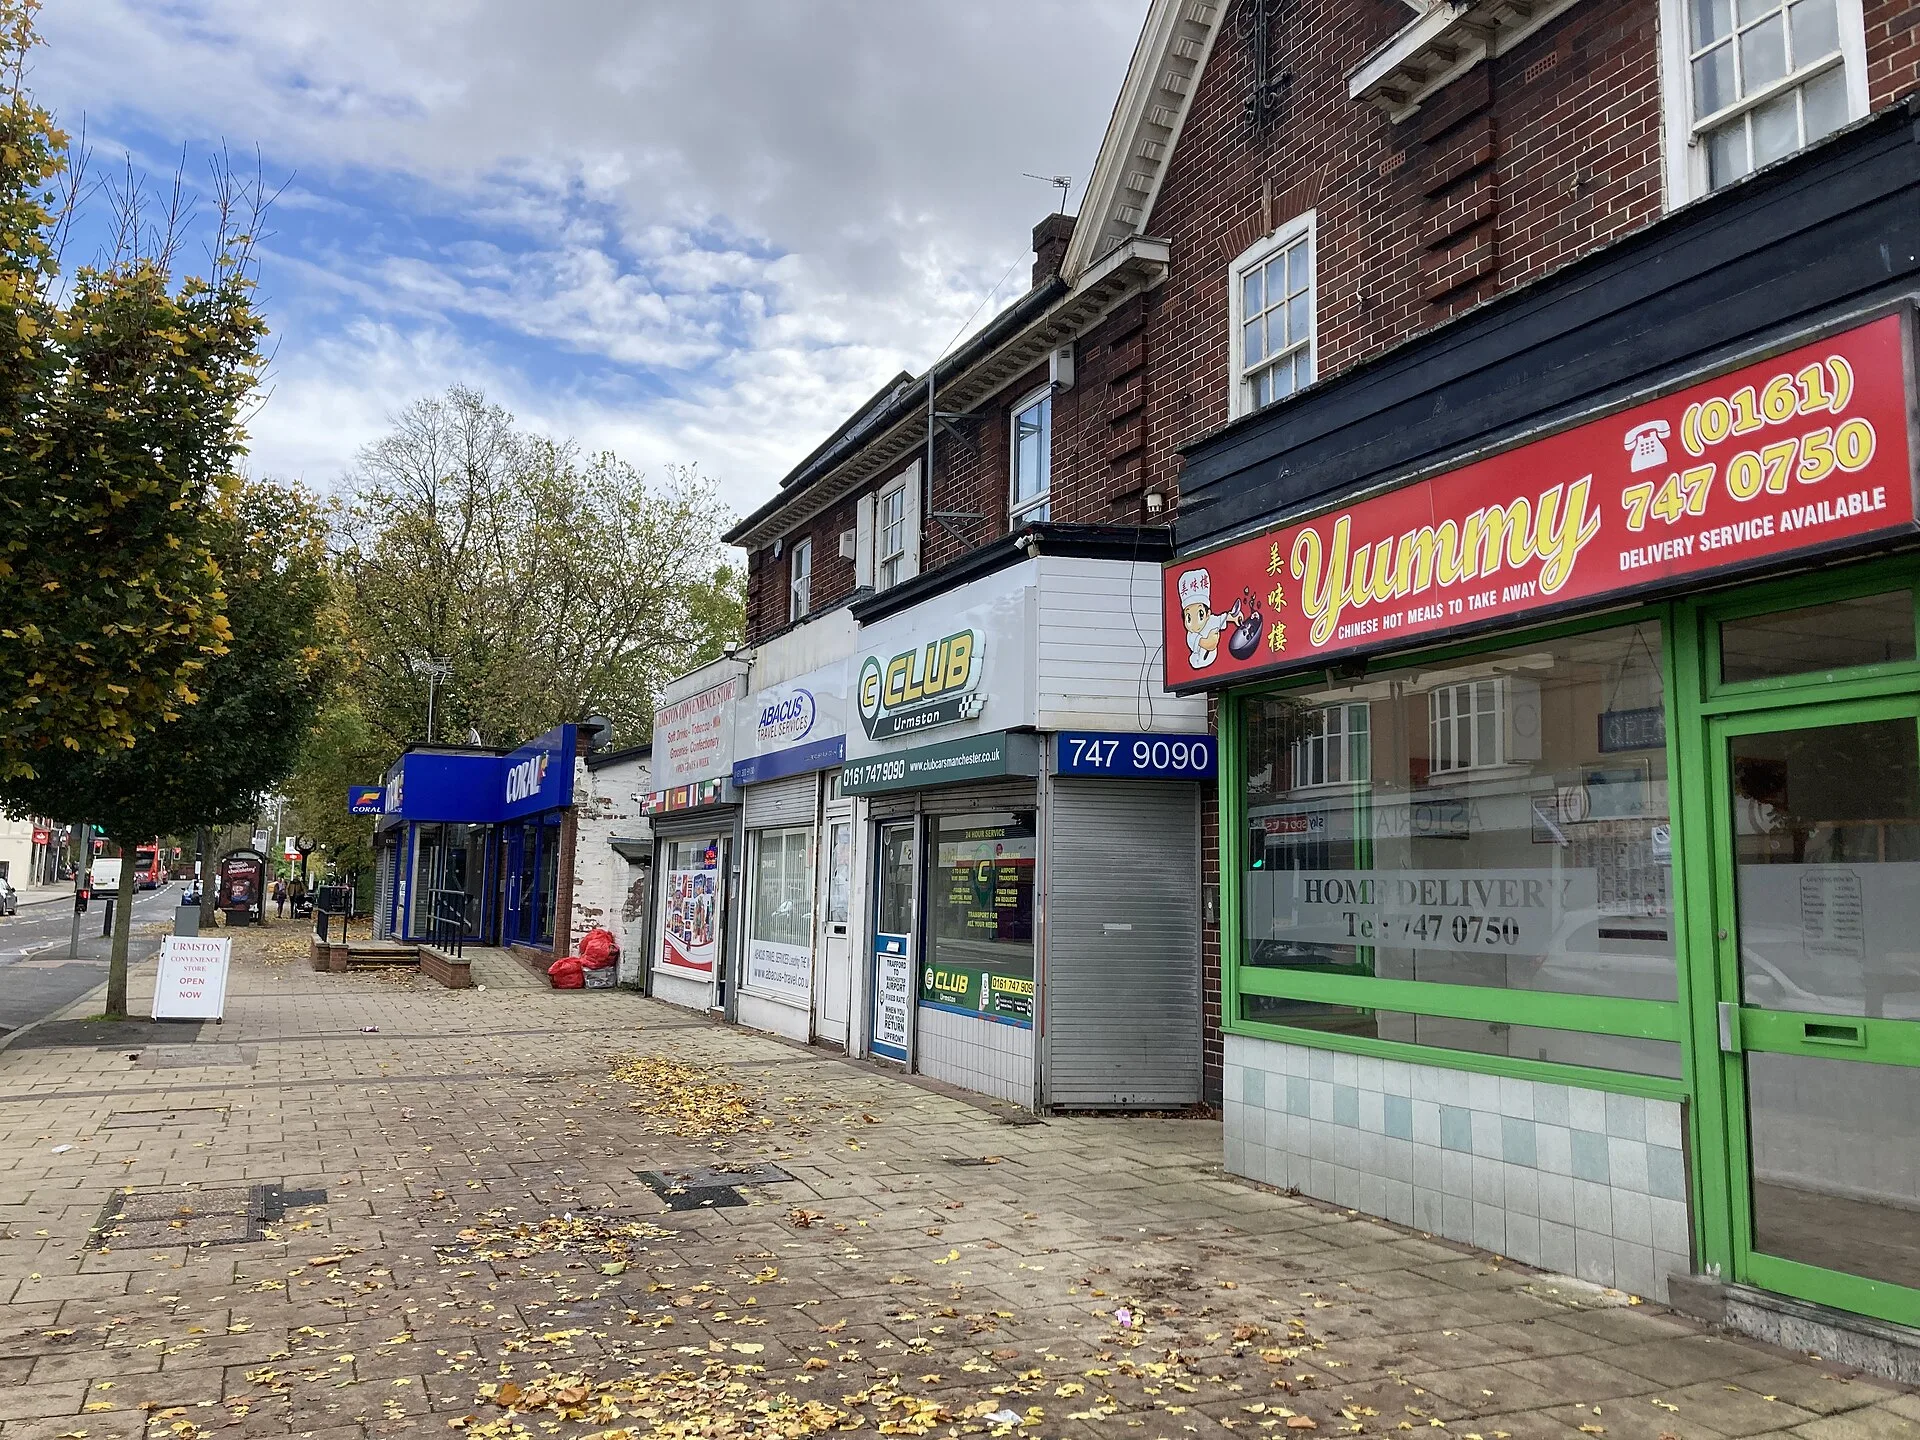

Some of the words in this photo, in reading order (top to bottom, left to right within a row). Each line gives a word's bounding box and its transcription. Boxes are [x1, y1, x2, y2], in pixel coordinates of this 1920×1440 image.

[1681, 355, 1854, 456] (0161)
[1622, 463, 1716, 531] 747
[1726, 417, 1876, 502] 0750
[1620, 535, 1695, 571] DELIVERY
[1700, 515, 1774, 551] SERVICE
[1780, 487, 1886, 531] AVAILABLE
[1290, 474, 1601, 647] Yummy
[1338, 618, 1378, 640] CHINESE
[1382, 612, 1403, 629] HOT
[1407, 605, 1443, 624] MEALS
[1448, 600, 1462, 615] TO
[1468, 591, 1497, 610] TAKE
[1502, 579, 1536, 602] AWAY
[883, 630, 974, 708] CLUB
[758, 695, 803, 728] ABACUS
[893, 710, 940, 730] Urmston
[757, 726, 777, 741] TRAVEL
[778, 715, 808, 735] SERVICES
[843, 767, 864, 787] 0161
[865, 763, 882, 784] 747
[882, 759, 905, 782] 9090
[909, 748, 1000, 772] www.clubcarsmanchester.co.uk
[1069, 739, 1119, 767] 747
[1132, 740, 1208, 770] 9090
[506, 754, 542, 804] CORAL
[972, 830, 984, 838] HOUR
[985, 829, 1005, 837] SERVICE
[1304, 878, 1387, 906] HOME
[1396, 878, 1573, 908] DELIVERY
[1452, 915, 1520, 946] 0750
[172, 943, 221, 952] URMSTON
[886, 960, 906, 969] TRAFFORD
[886, 982, 906, 992] AIRPORT
[935, 971, 969, 993] CLUB
[993, 978, 1007, 989] 0161
[1008, 980, 1019, 991] 747
[885, 1006, 896, 1014] WHEN
[896, 996, 905, 1004] RATE
[884, 1020, 905, 1032] RETURN
[884, 1032, 904, 1043] UPFRONT
